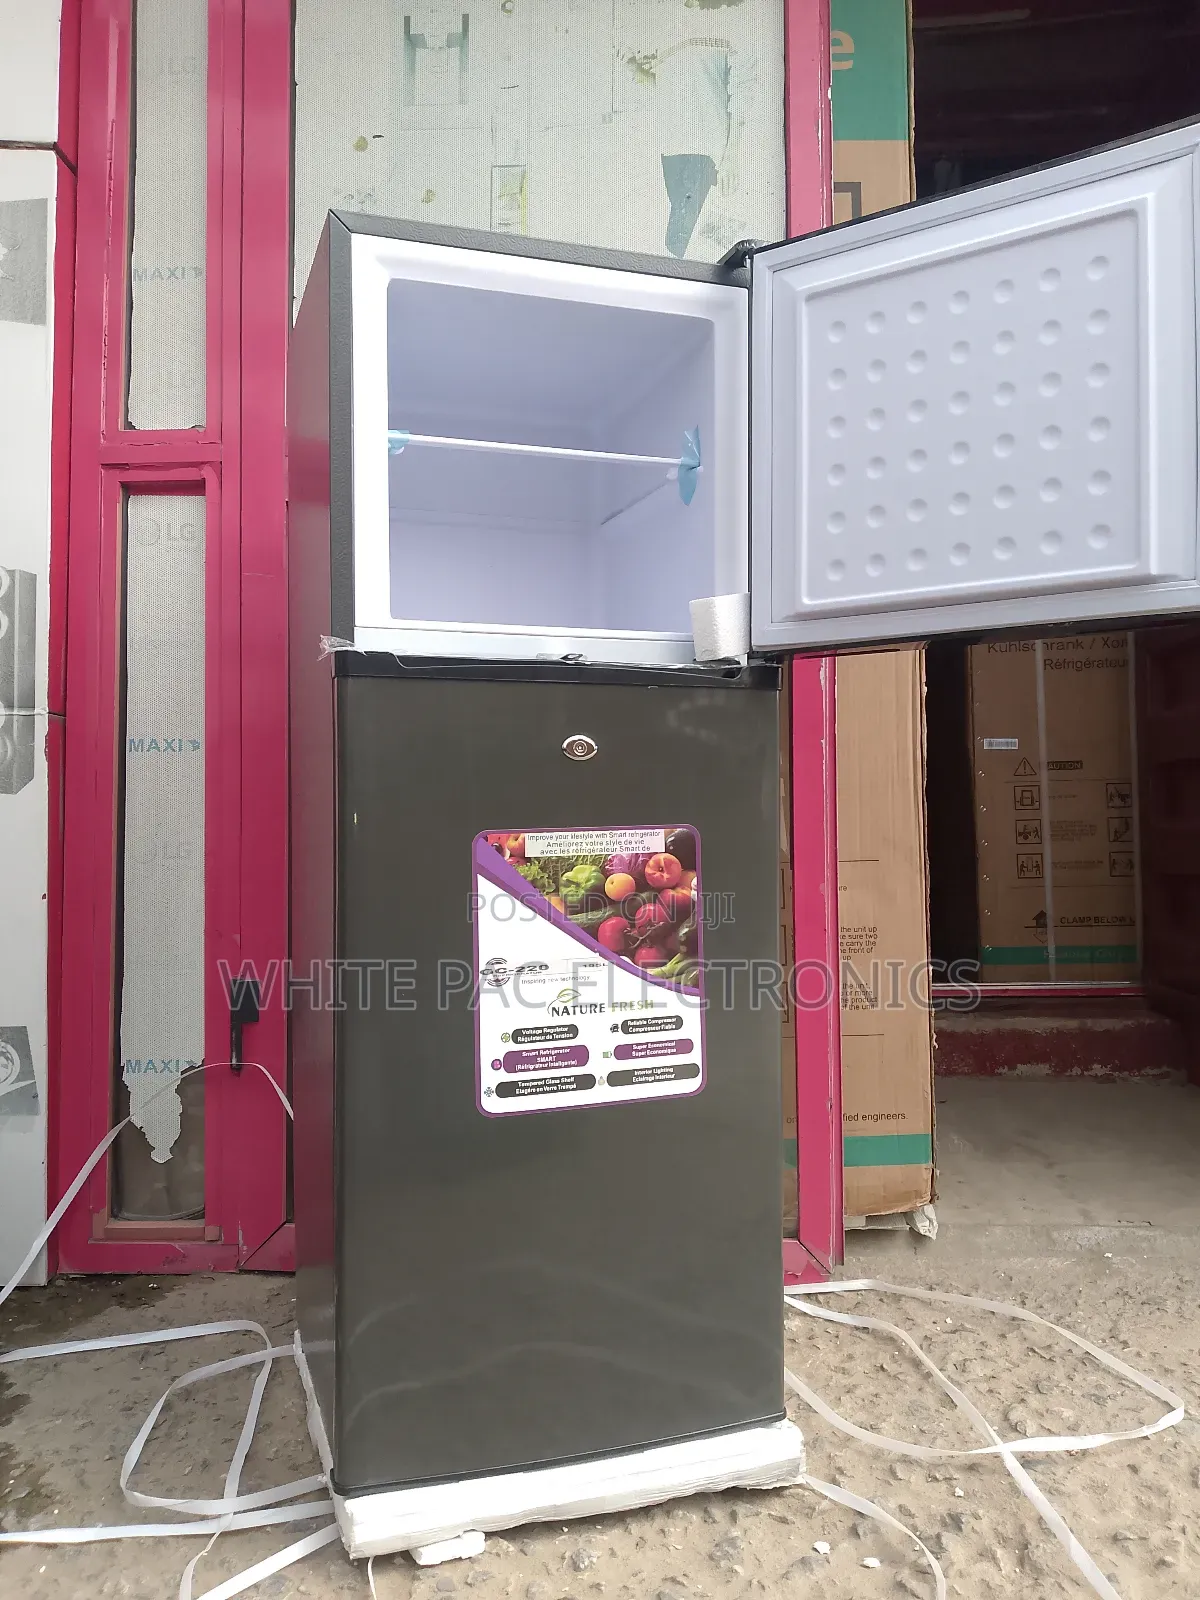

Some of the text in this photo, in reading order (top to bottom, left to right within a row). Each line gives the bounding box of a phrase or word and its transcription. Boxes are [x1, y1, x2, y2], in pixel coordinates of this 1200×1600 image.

[166, 522, 197, 542] LG
[129, 738, 184, 753] MAXI
[1047, 762, 1082, 770] AUTION
[527, 834, 554, 842] Improve
[555, 833, 569, 841] your
[595, 831, 608, 839] with
[619, 845, 640, 853] Smart
[869, 926, 878, 934] up
[551, 999, 654, 1017] NATURE FRESH
[125, 1059, 180, 1073] MAXI
[861, 1112, 909, 1123] engineers.
